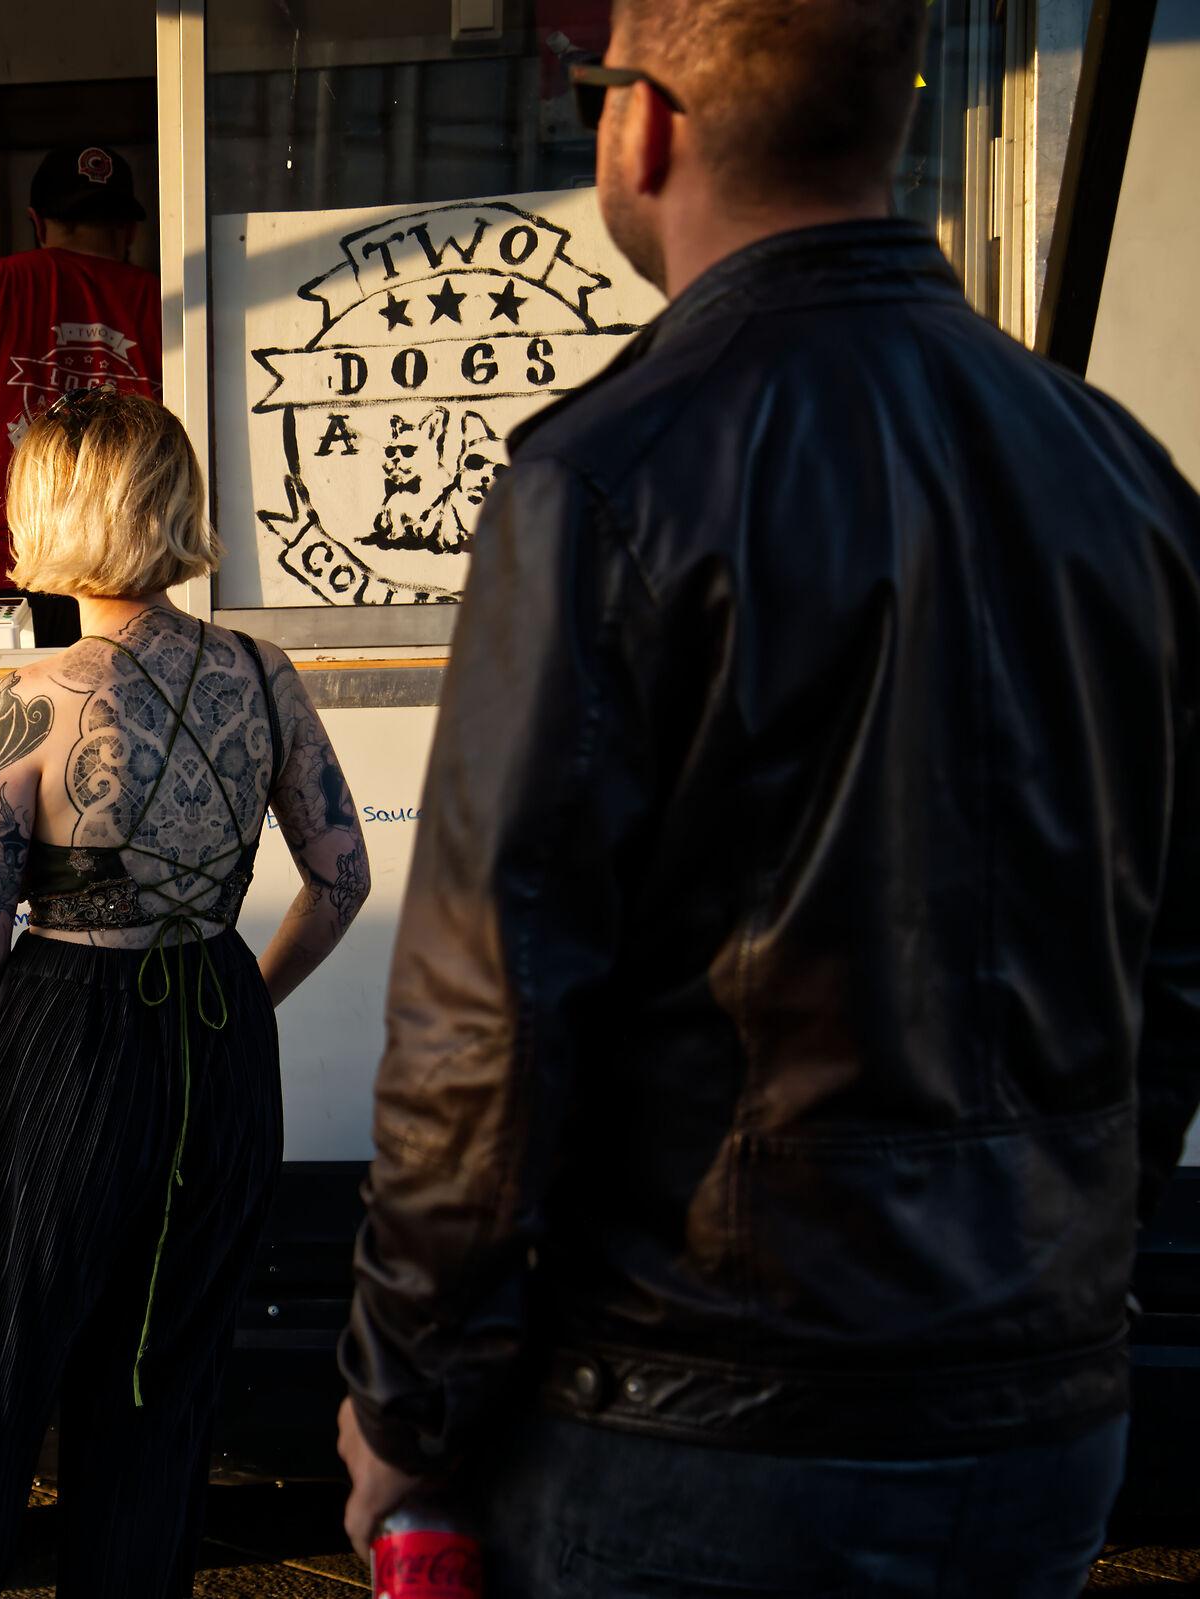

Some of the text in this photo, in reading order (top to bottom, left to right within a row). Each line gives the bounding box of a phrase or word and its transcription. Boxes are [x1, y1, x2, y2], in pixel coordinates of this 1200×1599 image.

[362, 217, 538, 280] TWO
[77, 328, 108, 338] TWO
[334, 338, 556, 396] DOGS
[314, 413, 360, 456] A
